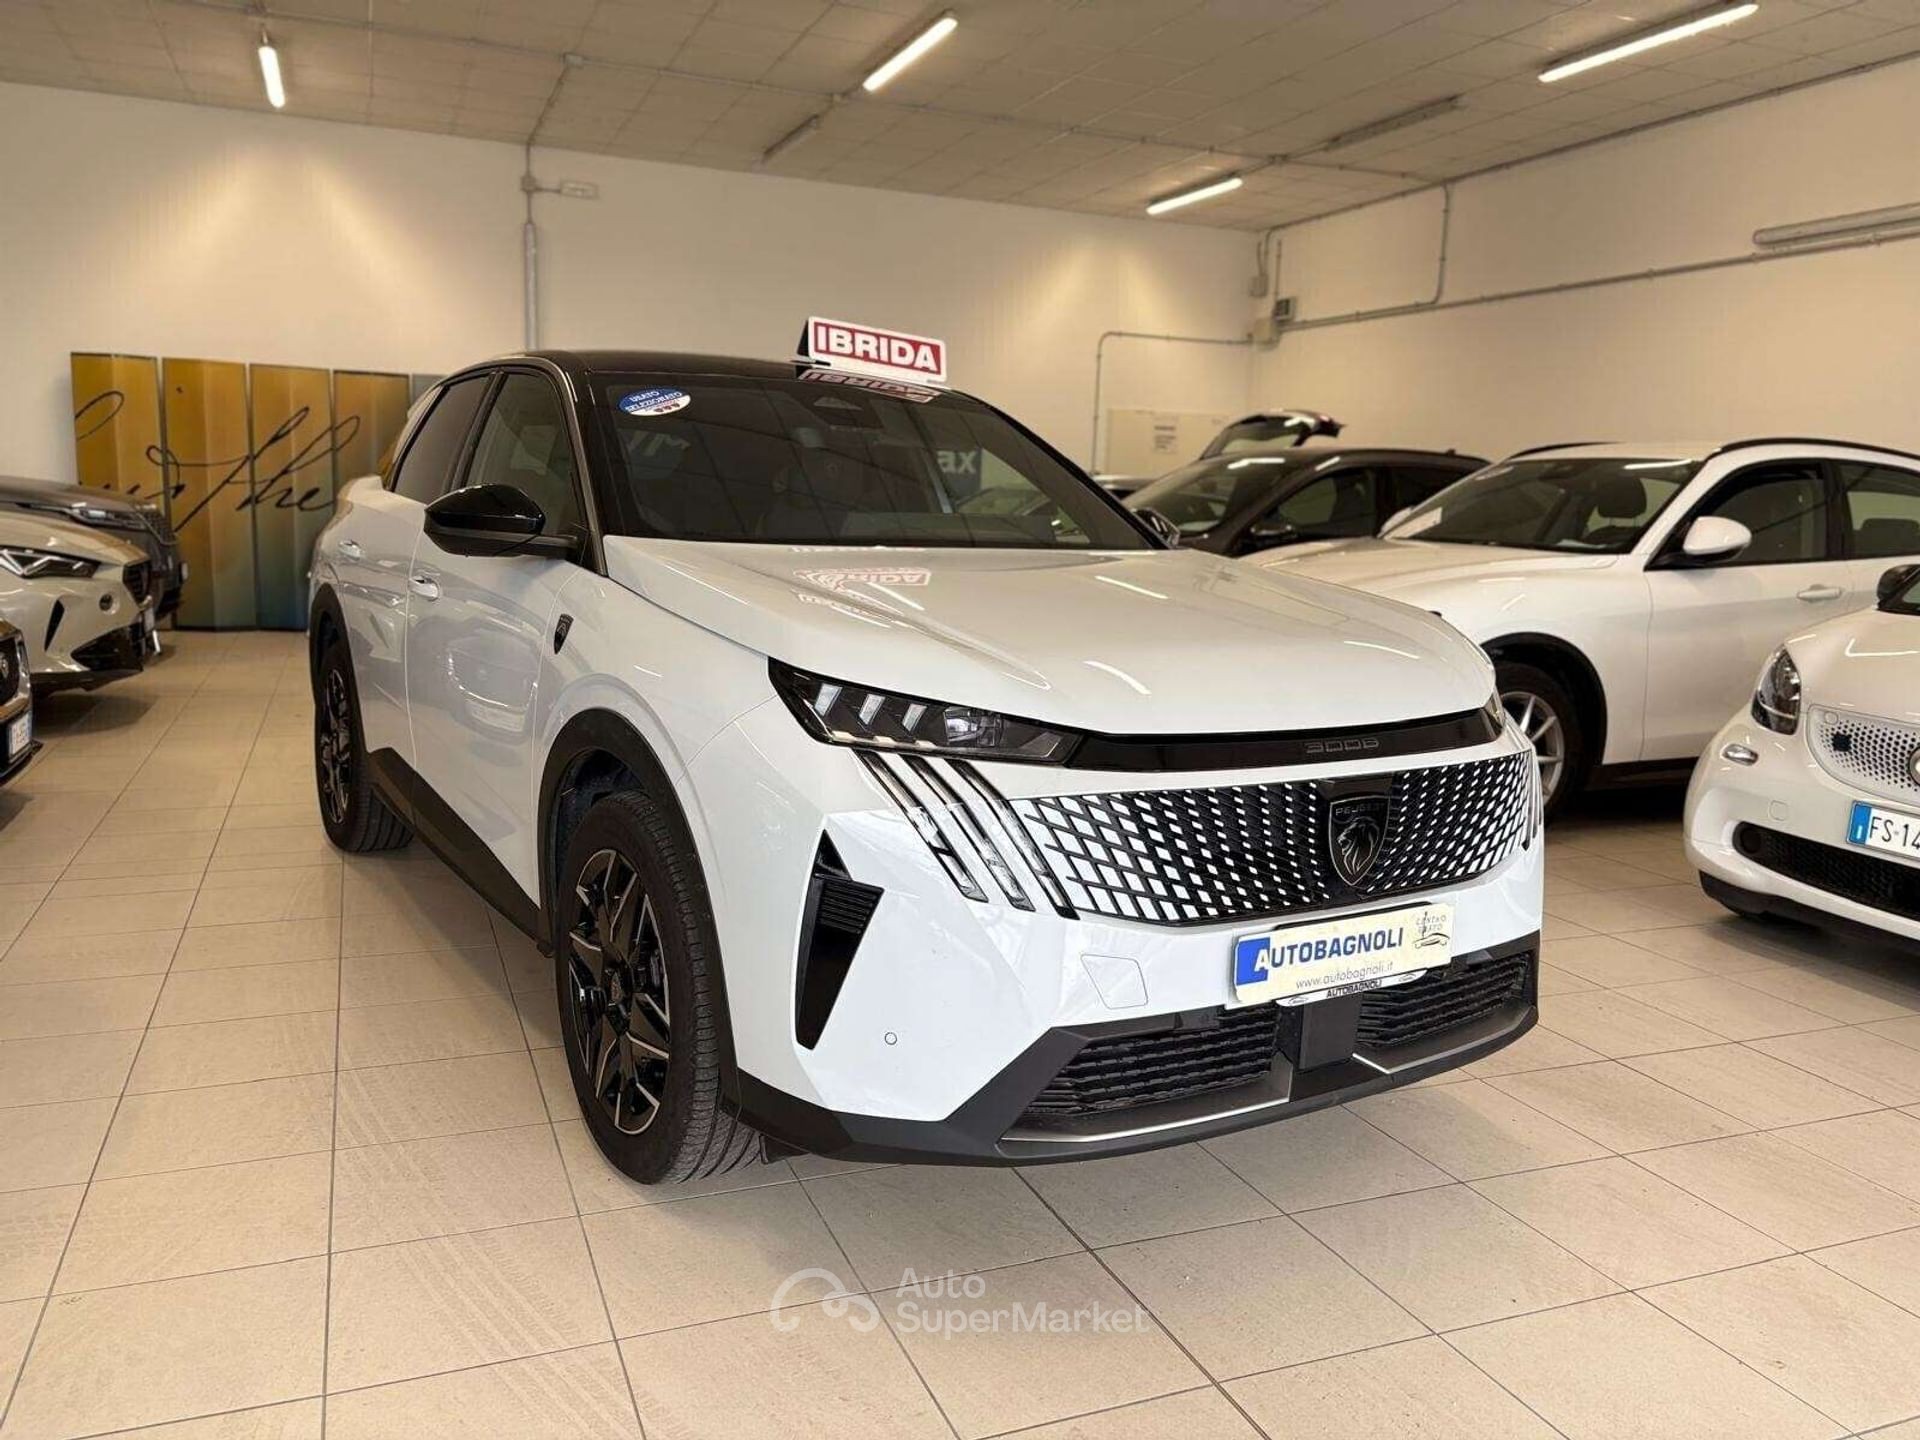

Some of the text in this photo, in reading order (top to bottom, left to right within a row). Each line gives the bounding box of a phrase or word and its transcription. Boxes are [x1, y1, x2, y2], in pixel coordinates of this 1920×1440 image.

[816, 325, 938, 371] IBRIDA
[1254, 927, 1404, 973] AUTOBAGNOLI
[1295, 961, 1394, 990] www.autobagnoli.it
[1326, 979, 1383, 999] AUTOBAGNOLI
